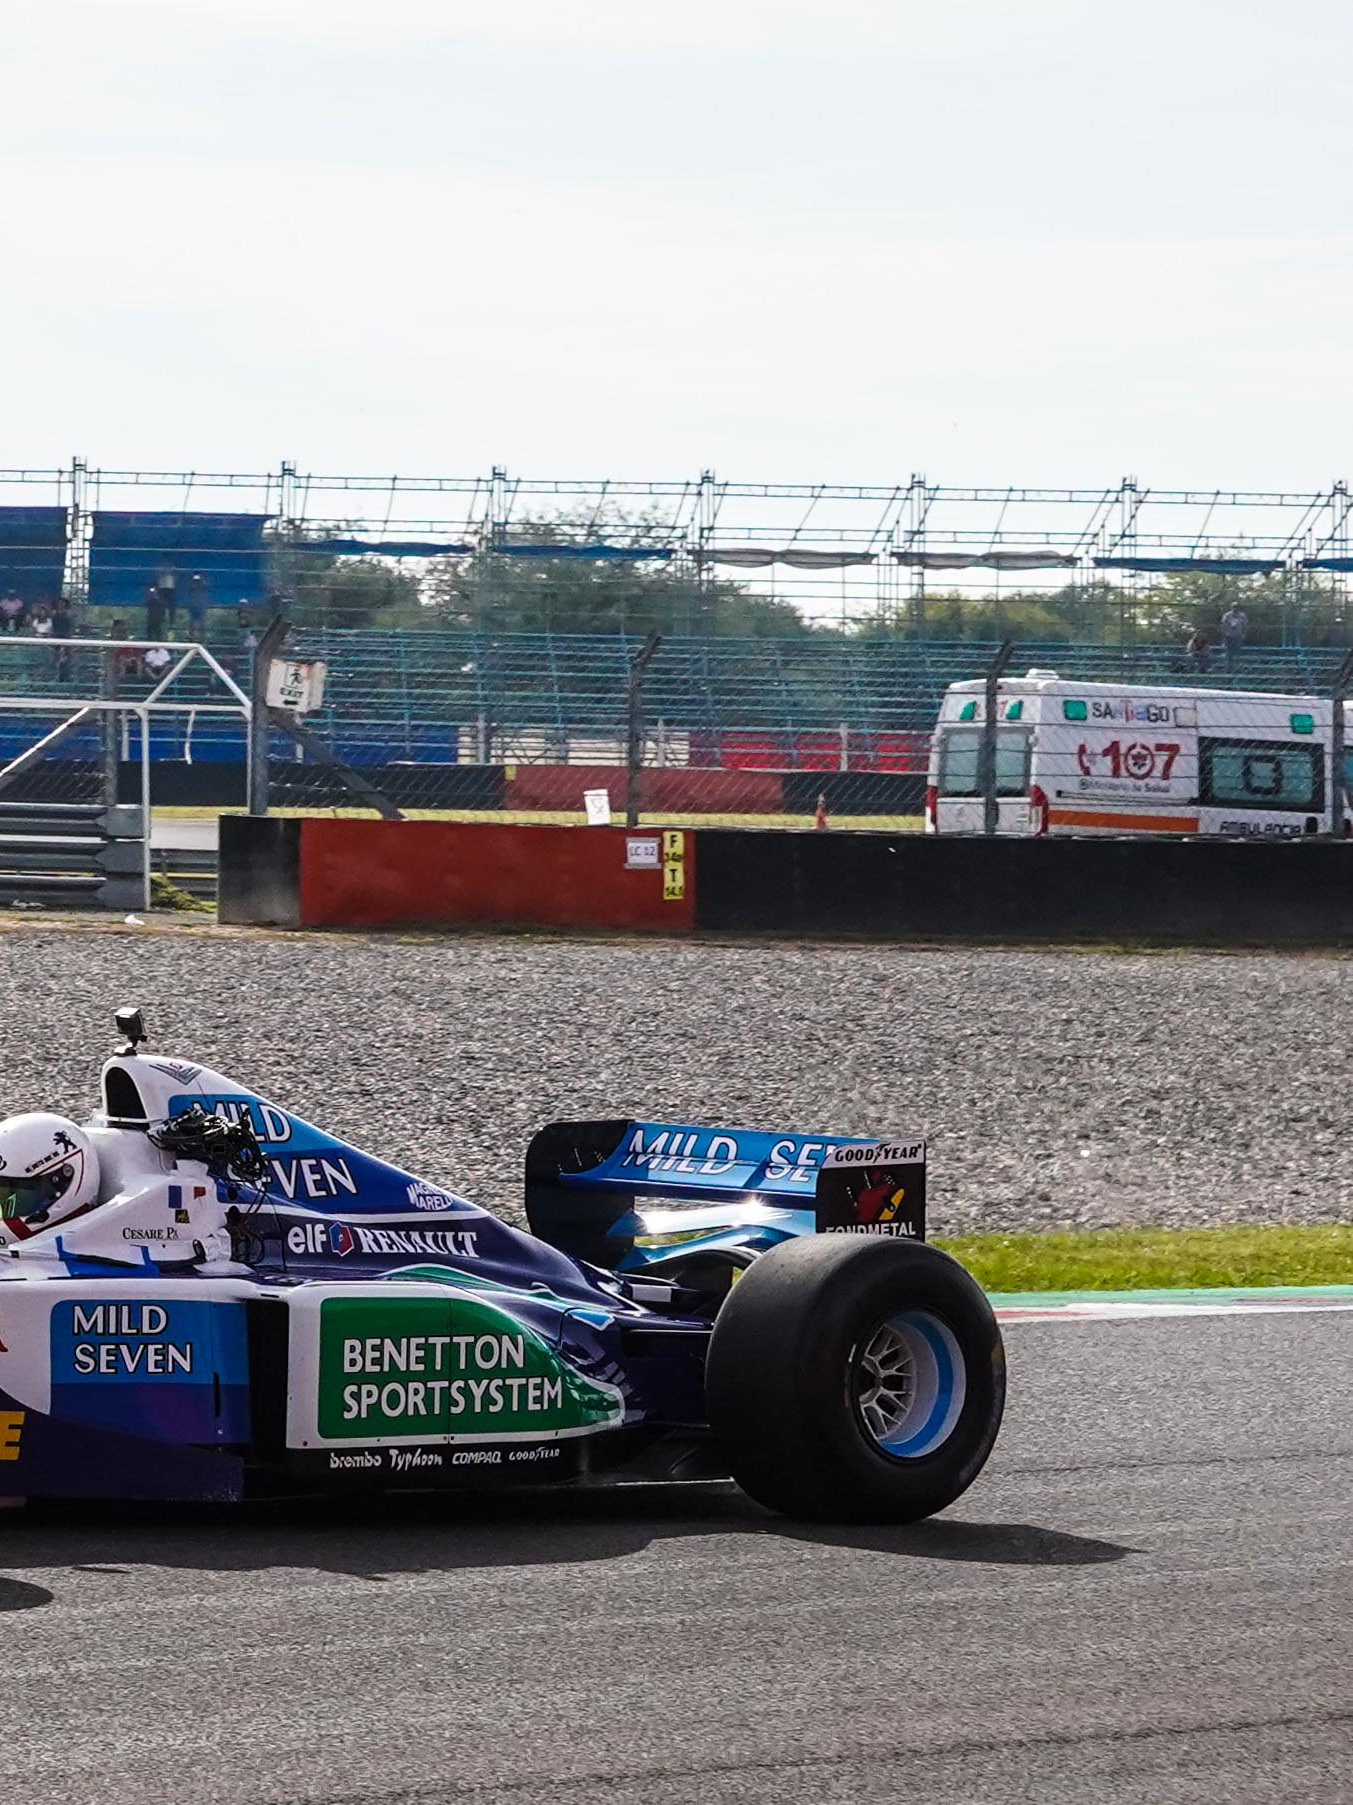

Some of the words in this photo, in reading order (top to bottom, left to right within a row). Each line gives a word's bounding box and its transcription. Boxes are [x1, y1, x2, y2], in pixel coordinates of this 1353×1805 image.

[1102, 740, 1181, 780] 107
[670, 834, 678, 848] F
[669, 868, 678, 882] T
[622, 1129, 739, 1175] MILD
[763, 1138, 834, 1183] SE
[287, 1223, 327, 1254] elf
[353, 1226, 480, 1258] RENAULT
[73, 1304, 168, 1335] MILD
[73, 1343, 192, 1374] SEVEN
[342, 1334, 525, 1374] BENETTON
[342, 1376, 563, 1420] SPORTSYSTEM
[329, 1450, 382, 1469] brembo
[389, 1448, 443, 1471] Typhoon
[452, 1451, 503, 1465] COMPAQ
